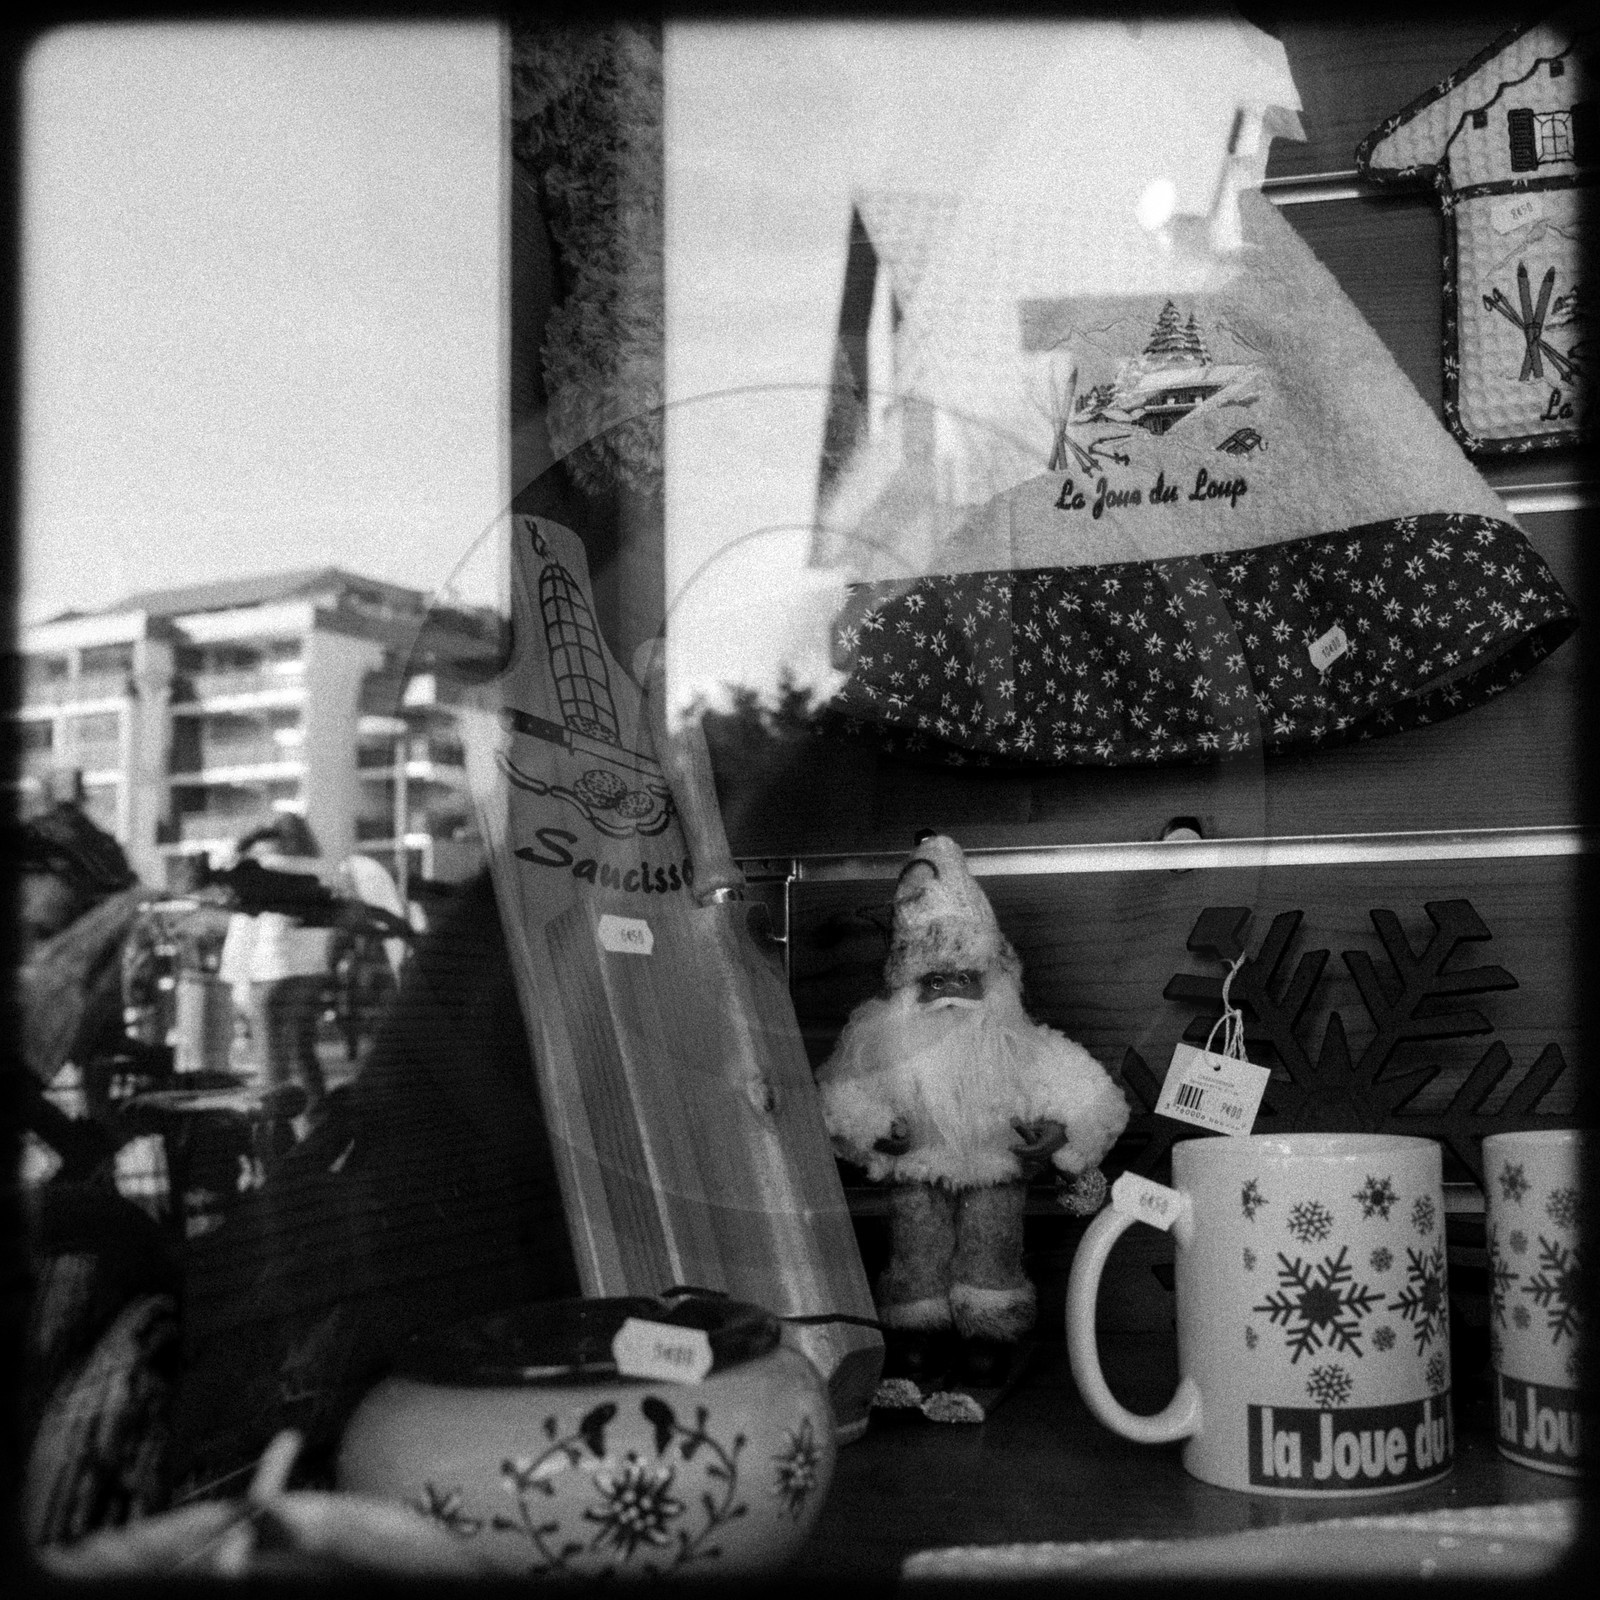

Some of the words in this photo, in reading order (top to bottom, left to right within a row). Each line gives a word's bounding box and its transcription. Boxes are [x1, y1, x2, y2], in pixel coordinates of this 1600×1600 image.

[1540, 387, 1574, 421] La
[1055, 478, 1087, 510] La
[1149, 471, 1178, 505] du
[1188, 467, 1248, 509] Loup
[1261, 1406, 1302, 1478] la
[1313, 1412, 1408, 1481] Joue
[1415, 1399, 1445, 1470] du
